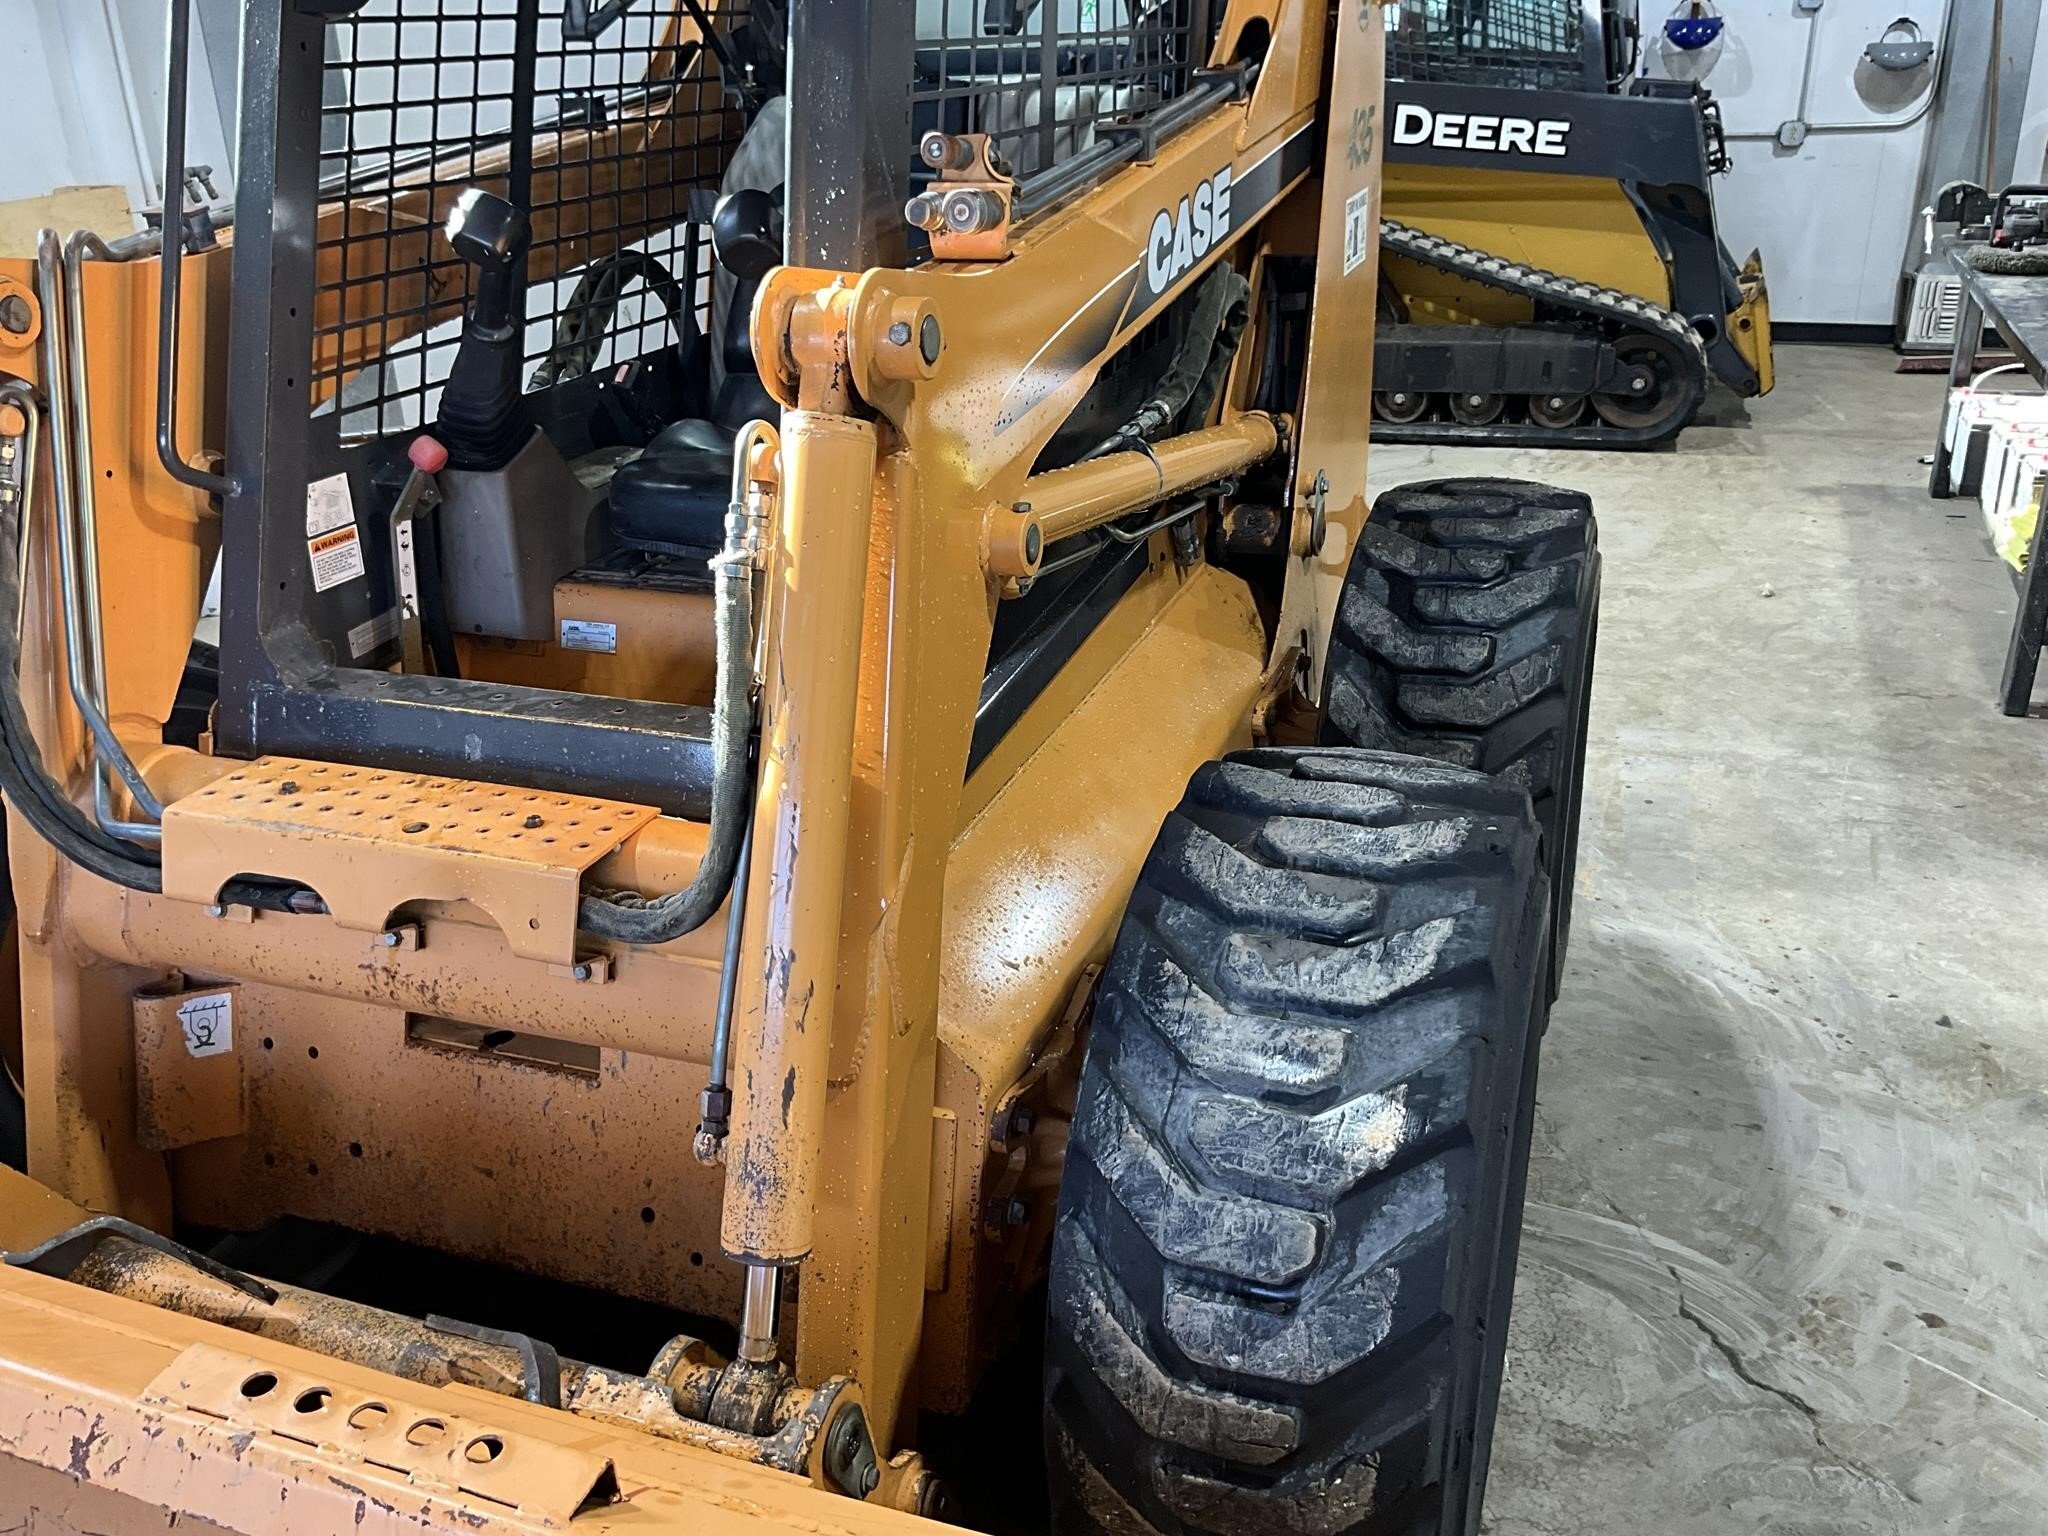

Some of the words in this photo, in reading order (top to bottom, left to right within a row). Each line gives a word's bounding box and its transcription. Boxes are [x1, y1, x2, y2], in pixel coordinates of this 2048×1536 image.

[1393, 104, 1570, 156] DEERE
[1147, 163, 1232, 294] CASE
[320, 531, 355, 550] WARNING
